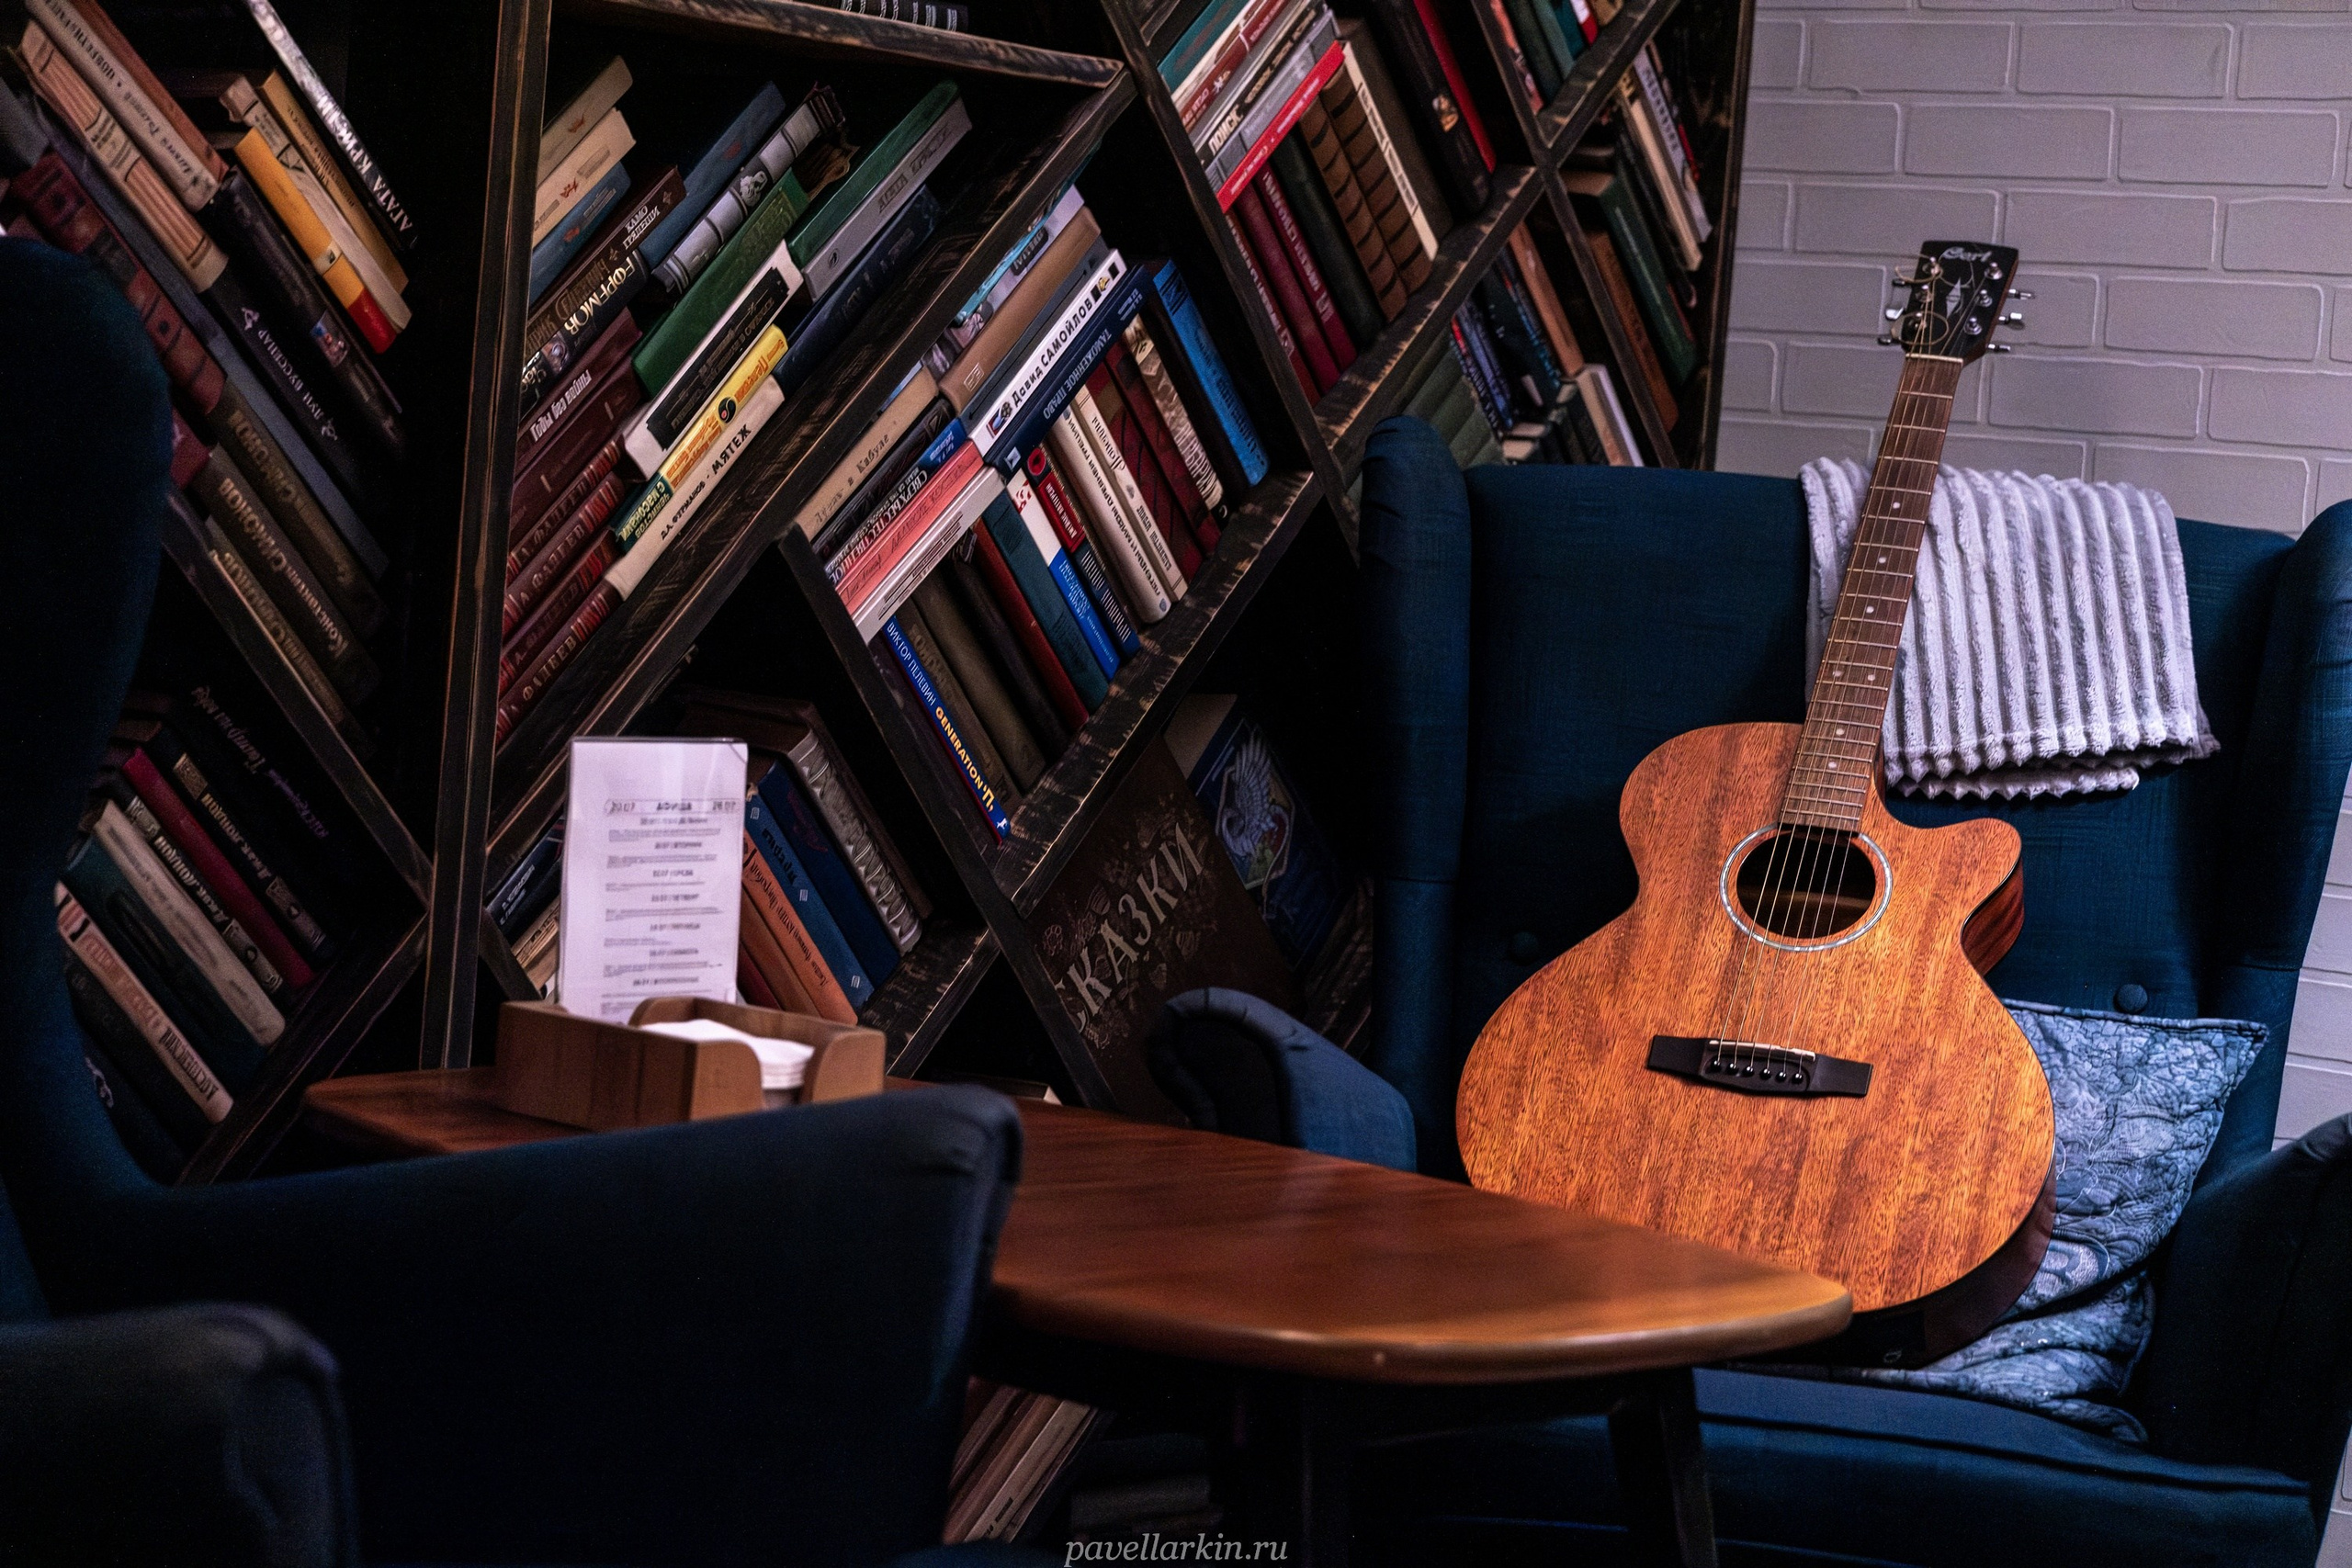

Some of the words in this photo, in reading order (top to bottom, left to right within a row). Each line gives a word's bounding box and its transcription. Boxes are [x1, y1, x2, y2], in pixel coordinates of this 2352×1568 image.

[1208, 104, 1242, 154] ПОИСК
[368, 175, 413, 232] АГАТА
[255, 326, 306, 390] БУССЕНАР
[1008, 364, 1044, 406] Давид
[1035, 296, 1095, 367] САМОЙЛОВ
[1064, 328, 1111, 391] ТАМОЖЕННОЕ
[300, 391, 324, 420] ЛУИ
[1042, 386, 1067, 420] ПРАВО
[708, 423, 753, 475] МЯТЕЖ
[854, 432, 892, 474] Кабуле
[1065, 418, 1091, 459] ГРЕЦИИ
[1086, 459, 1115, 506] ДРЕВНЕЙ
[212, 476, 291, 573] СИМОНОВ
[1110, 505, 1134, 543] МИФЫ
[1133, 550, 1161, 596] ЛЕГЕНДЫ
[884, 622, 913, 662] ВИКТОР
[905, 659, 939, 705] ПЕЛЕВИН
[931, 705, 988, 789] GENERATION
